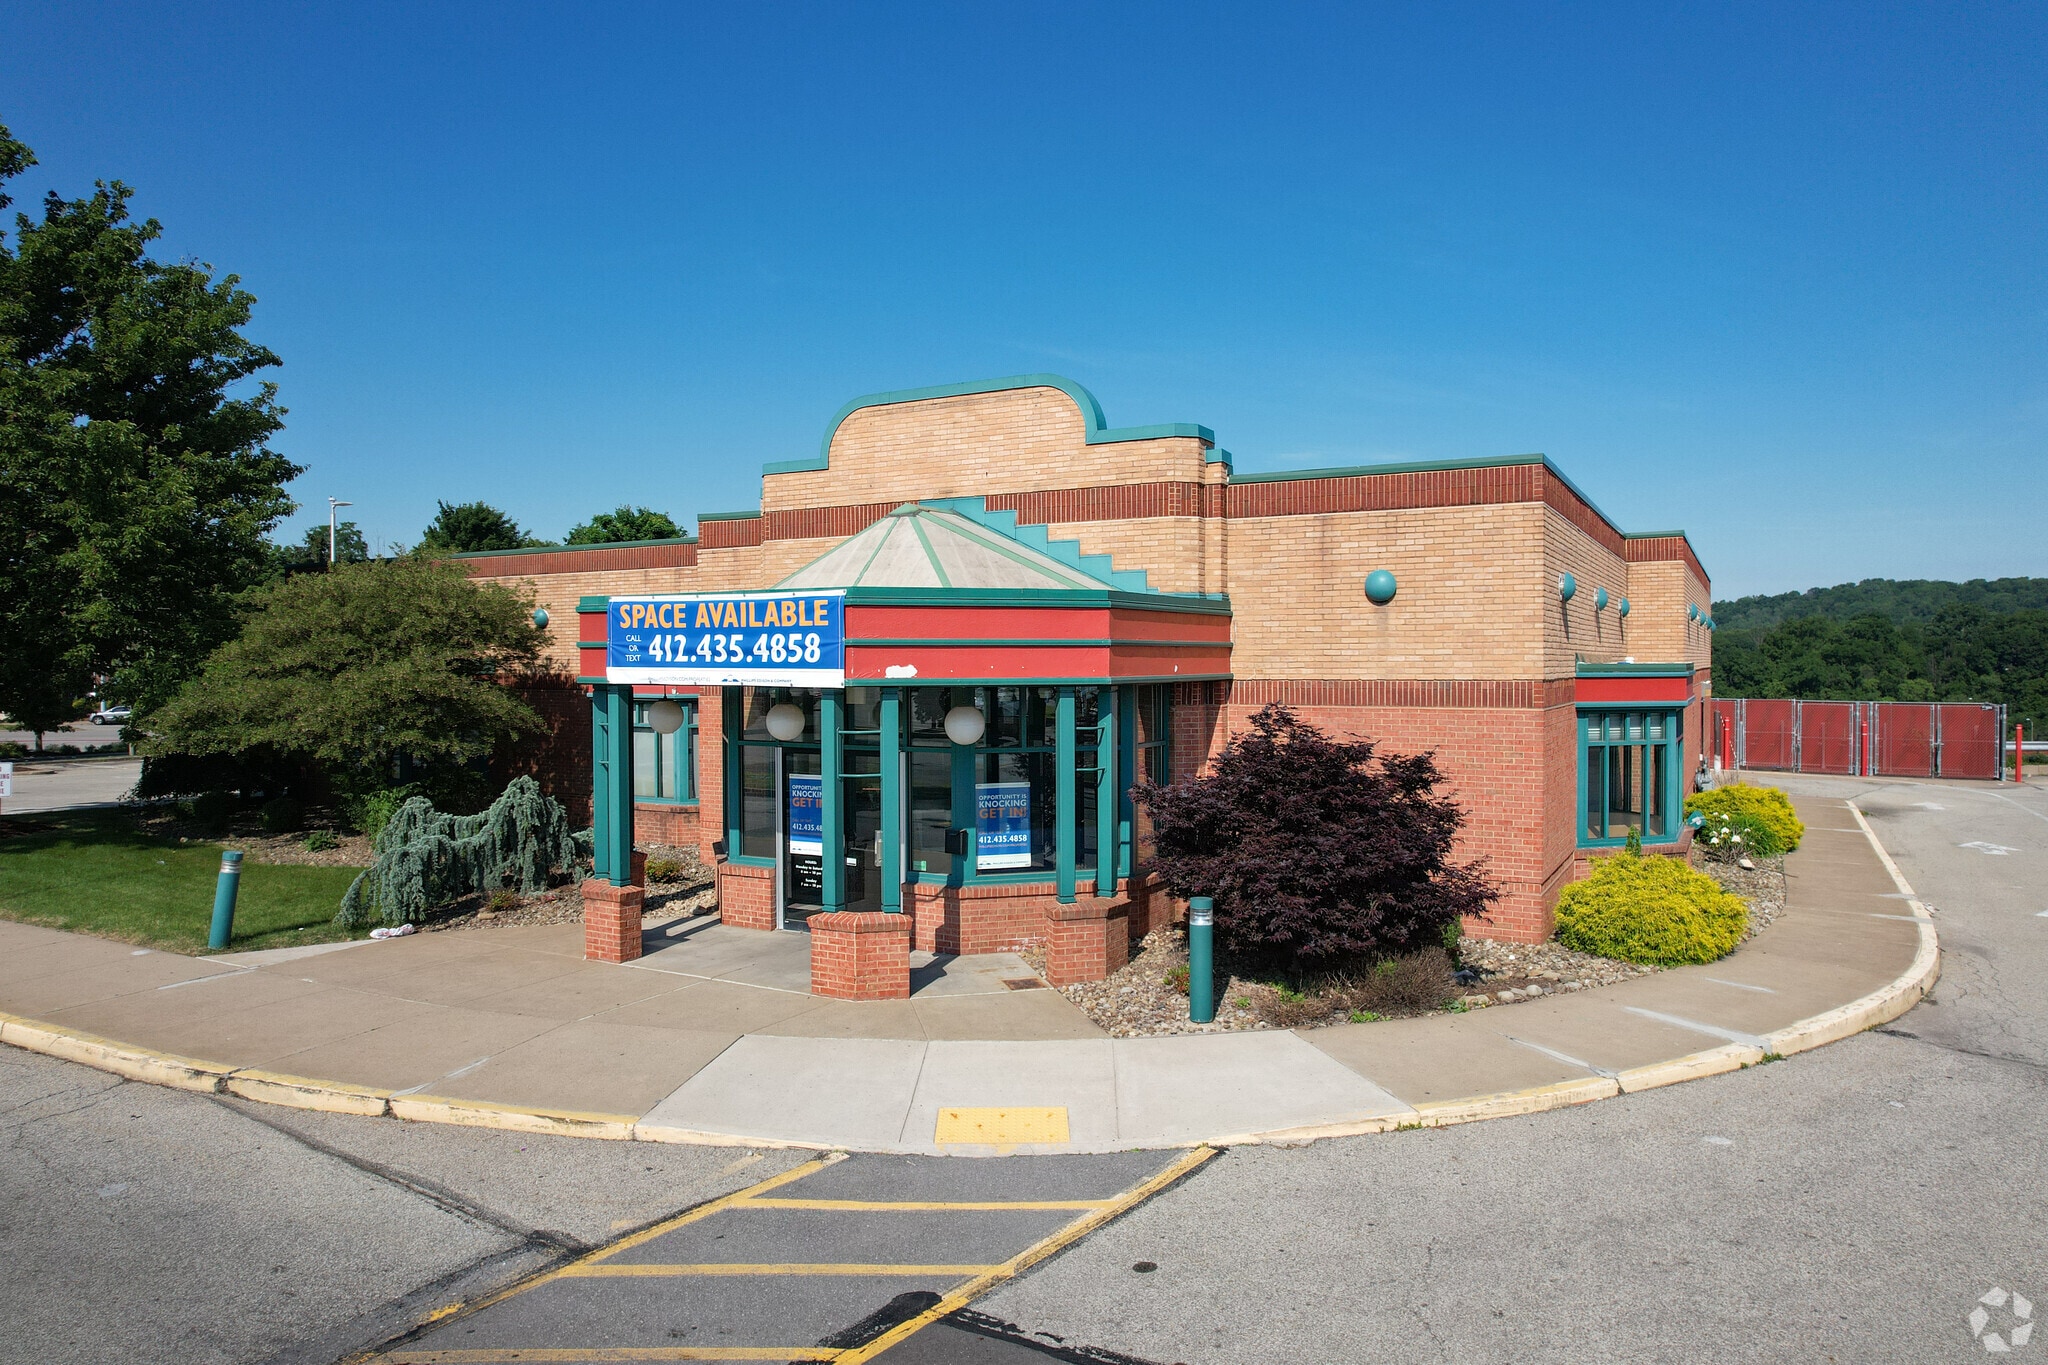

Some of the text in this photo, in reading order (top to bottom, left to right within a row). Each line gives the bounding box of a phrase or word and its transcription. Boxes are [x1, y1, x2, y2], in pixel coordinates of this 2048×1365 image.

[619, 599, 829, 629] SPACE AVAILABLE
[625, 634, 642, 643] CALL
[628, 644, 639, 653] OR
[648, 632, 821, 664] 412.435.4858
[625, 653, 641, 663] TEXT
[978, 793, 1020, 801] OPPORTUNITY
[792, 797, 813, 808] GET
[978, 799, 1027, 808] KNOCKING
[979, 807, 1027, 819] GET IN!
[978, 834, 1028, 844] 412.435.4858
